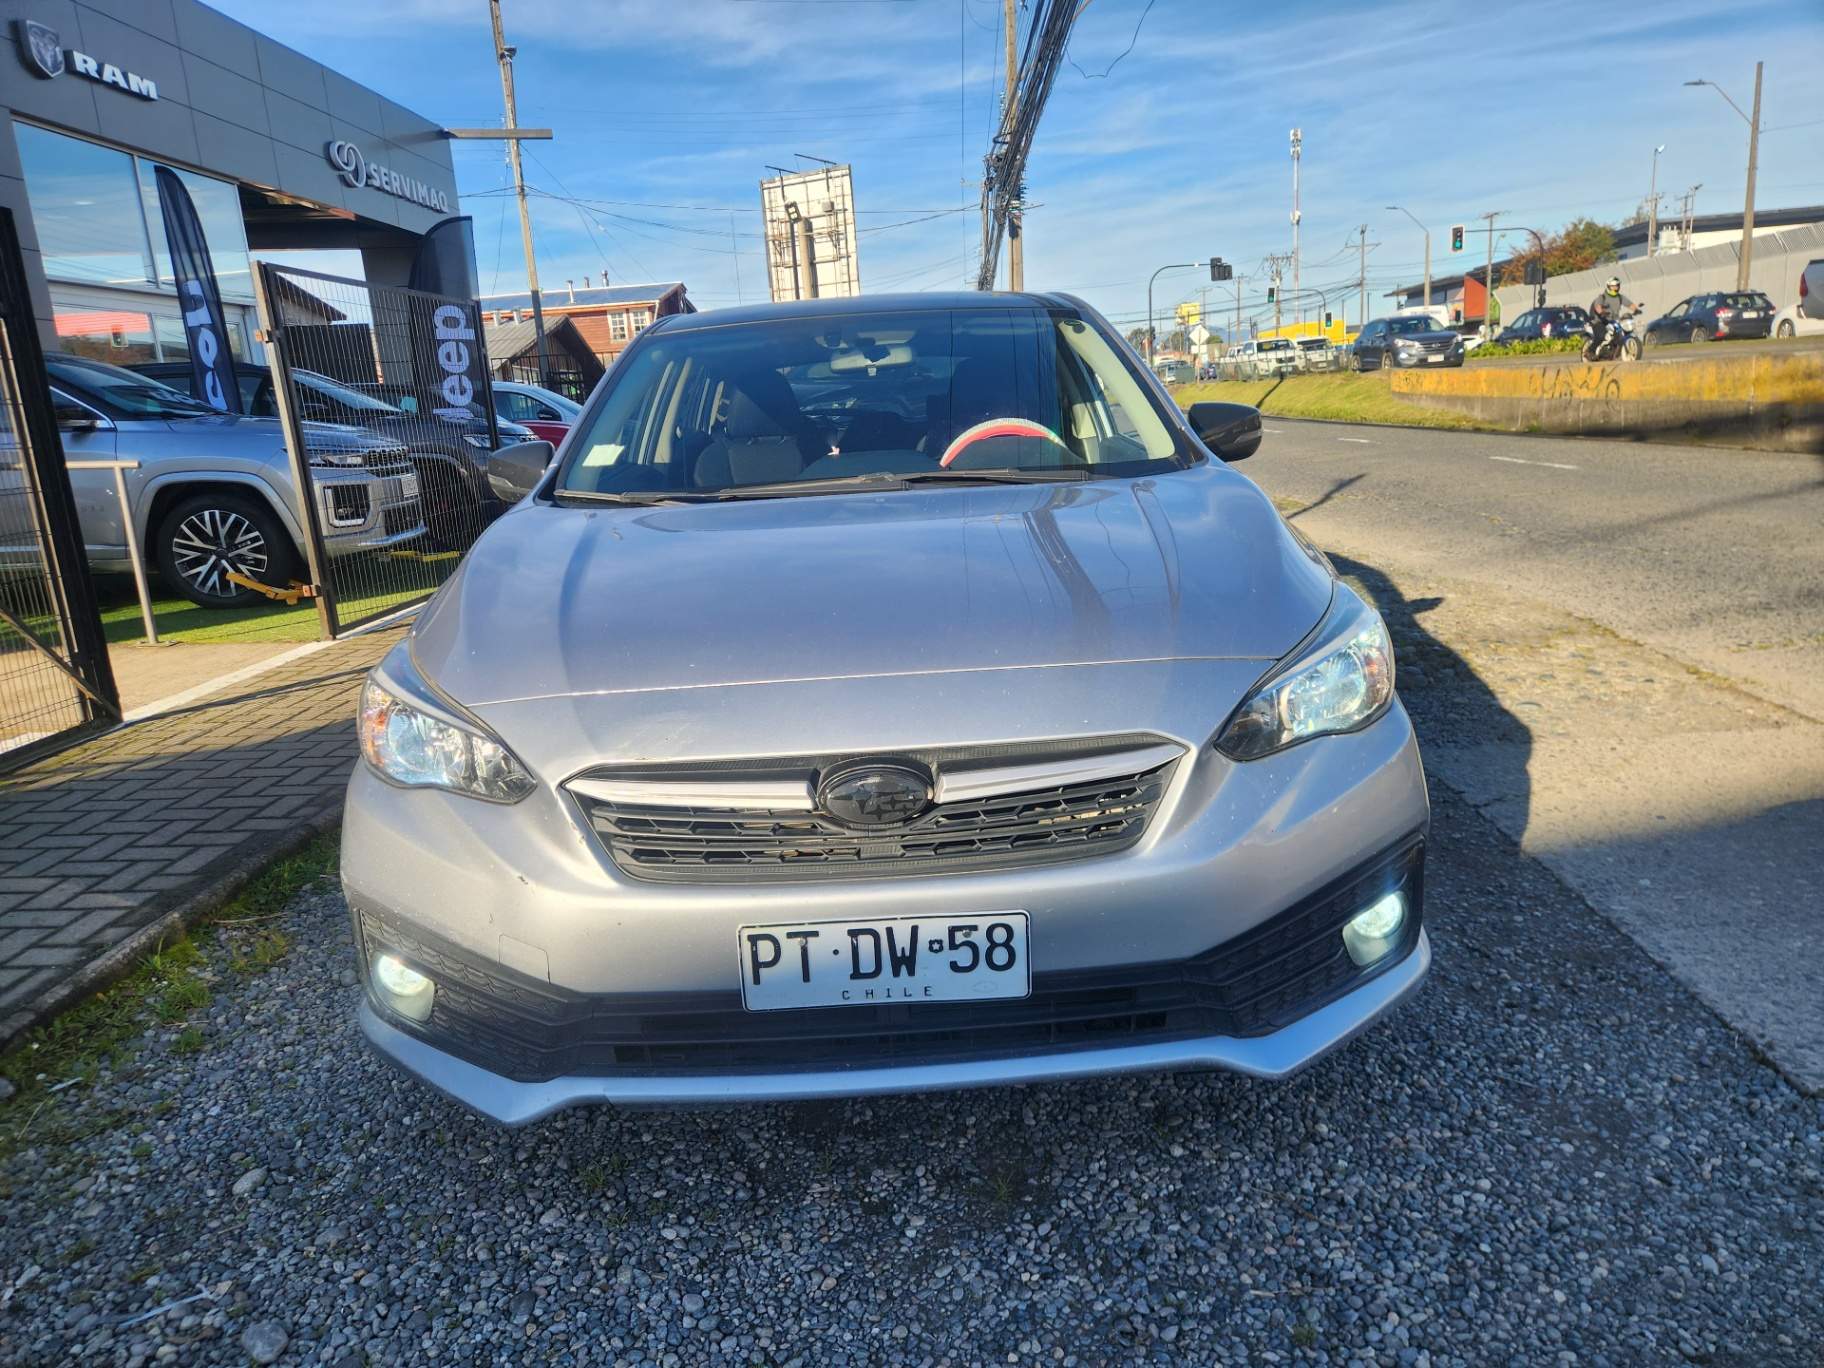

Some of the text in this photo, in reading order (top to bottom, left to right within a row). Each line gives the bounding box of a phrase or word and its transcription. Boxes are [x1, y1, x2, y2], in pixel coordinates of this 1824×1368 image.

[72, 50, 159, 101] RAM
[368, 163, 449, 213] SERVIMAQ
[841, 985, 933, 1001] CHILE
